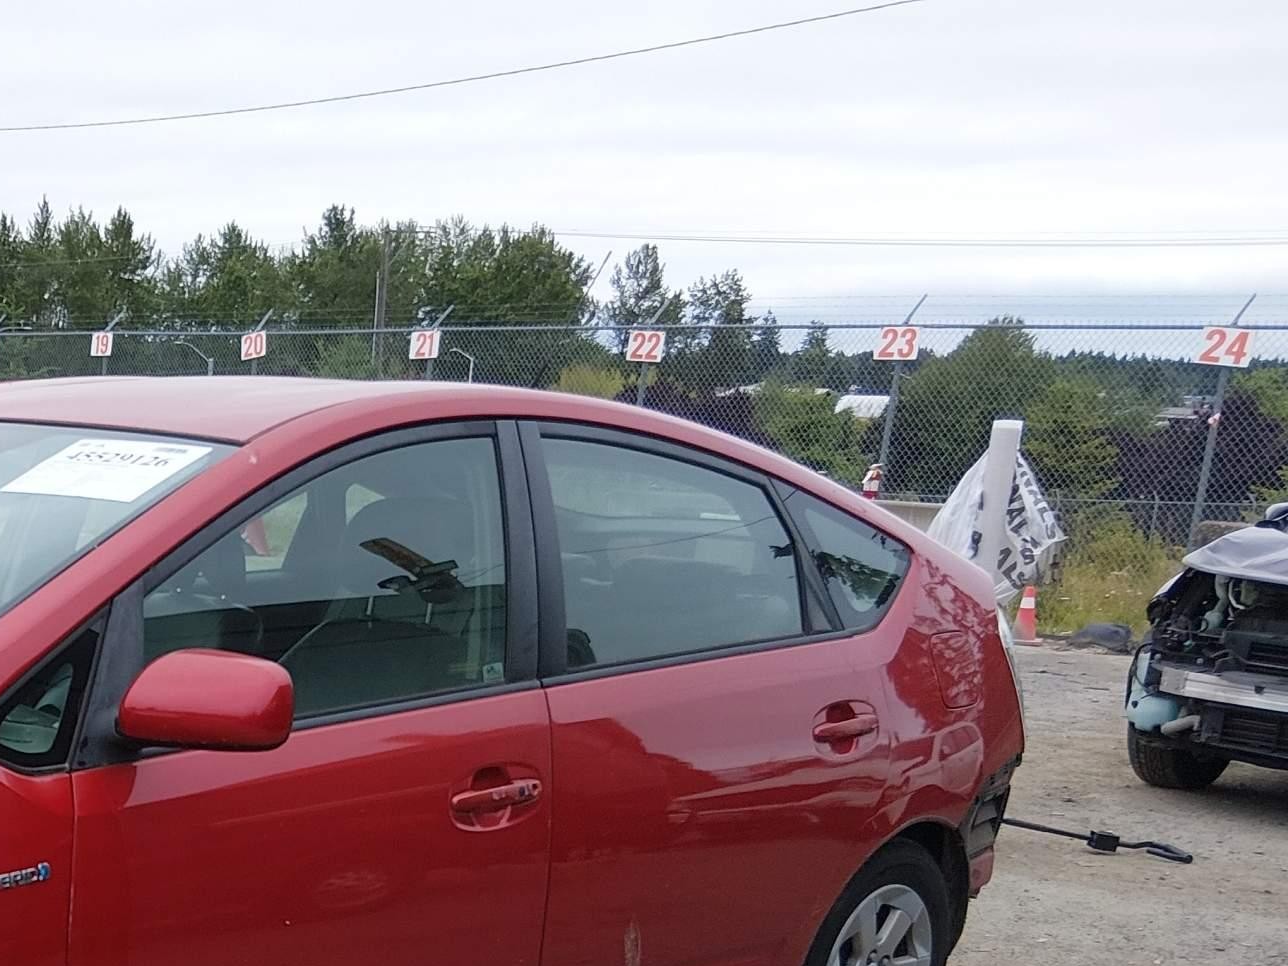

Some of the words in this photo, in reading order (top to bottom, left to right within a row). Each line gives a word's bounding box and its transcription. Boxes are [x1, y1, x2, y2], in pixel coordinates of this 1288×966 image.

[95, 333, 109, 355] 19
[243, 333, 264, 358] 20
[414, 332, 435, 358] 21
[629, 332, 661, 360] 22
[878, 328, 917, 358] 23
[1199, 329, 1249, 365] 24
